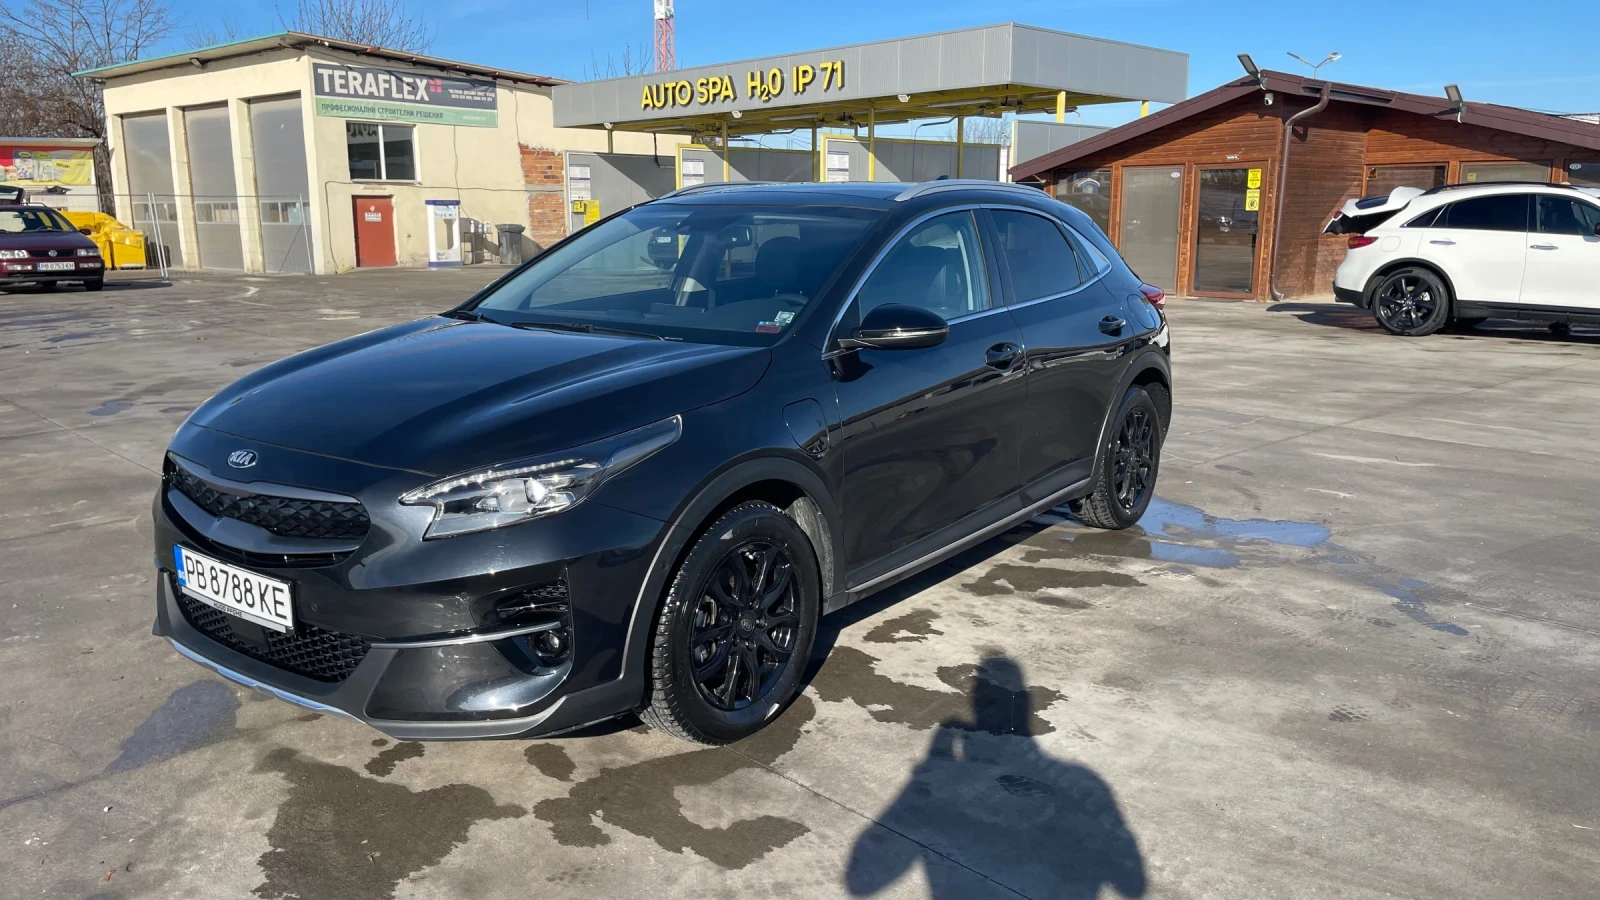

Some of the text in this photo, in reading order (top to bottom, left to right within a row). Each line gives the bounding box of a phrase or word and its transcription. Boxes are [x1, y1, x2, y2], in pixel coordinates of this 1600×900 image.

[317, 68, 430, 102] TERAFLEX
[641, 80, 693, 109] AUTO
[696, 75, 736, 104] SPA
[792, 64, 814, 93] IP
[819, 60, 843, 90] 71
[321, 103, 444, 119] ПРОФЕСИОНАЛНИ СТРОИТЕЛНИ РЕШЕНИЯ
[229, 450, 254, 466] KIA
[184, 554, 288, 621] PB 8788 KE
